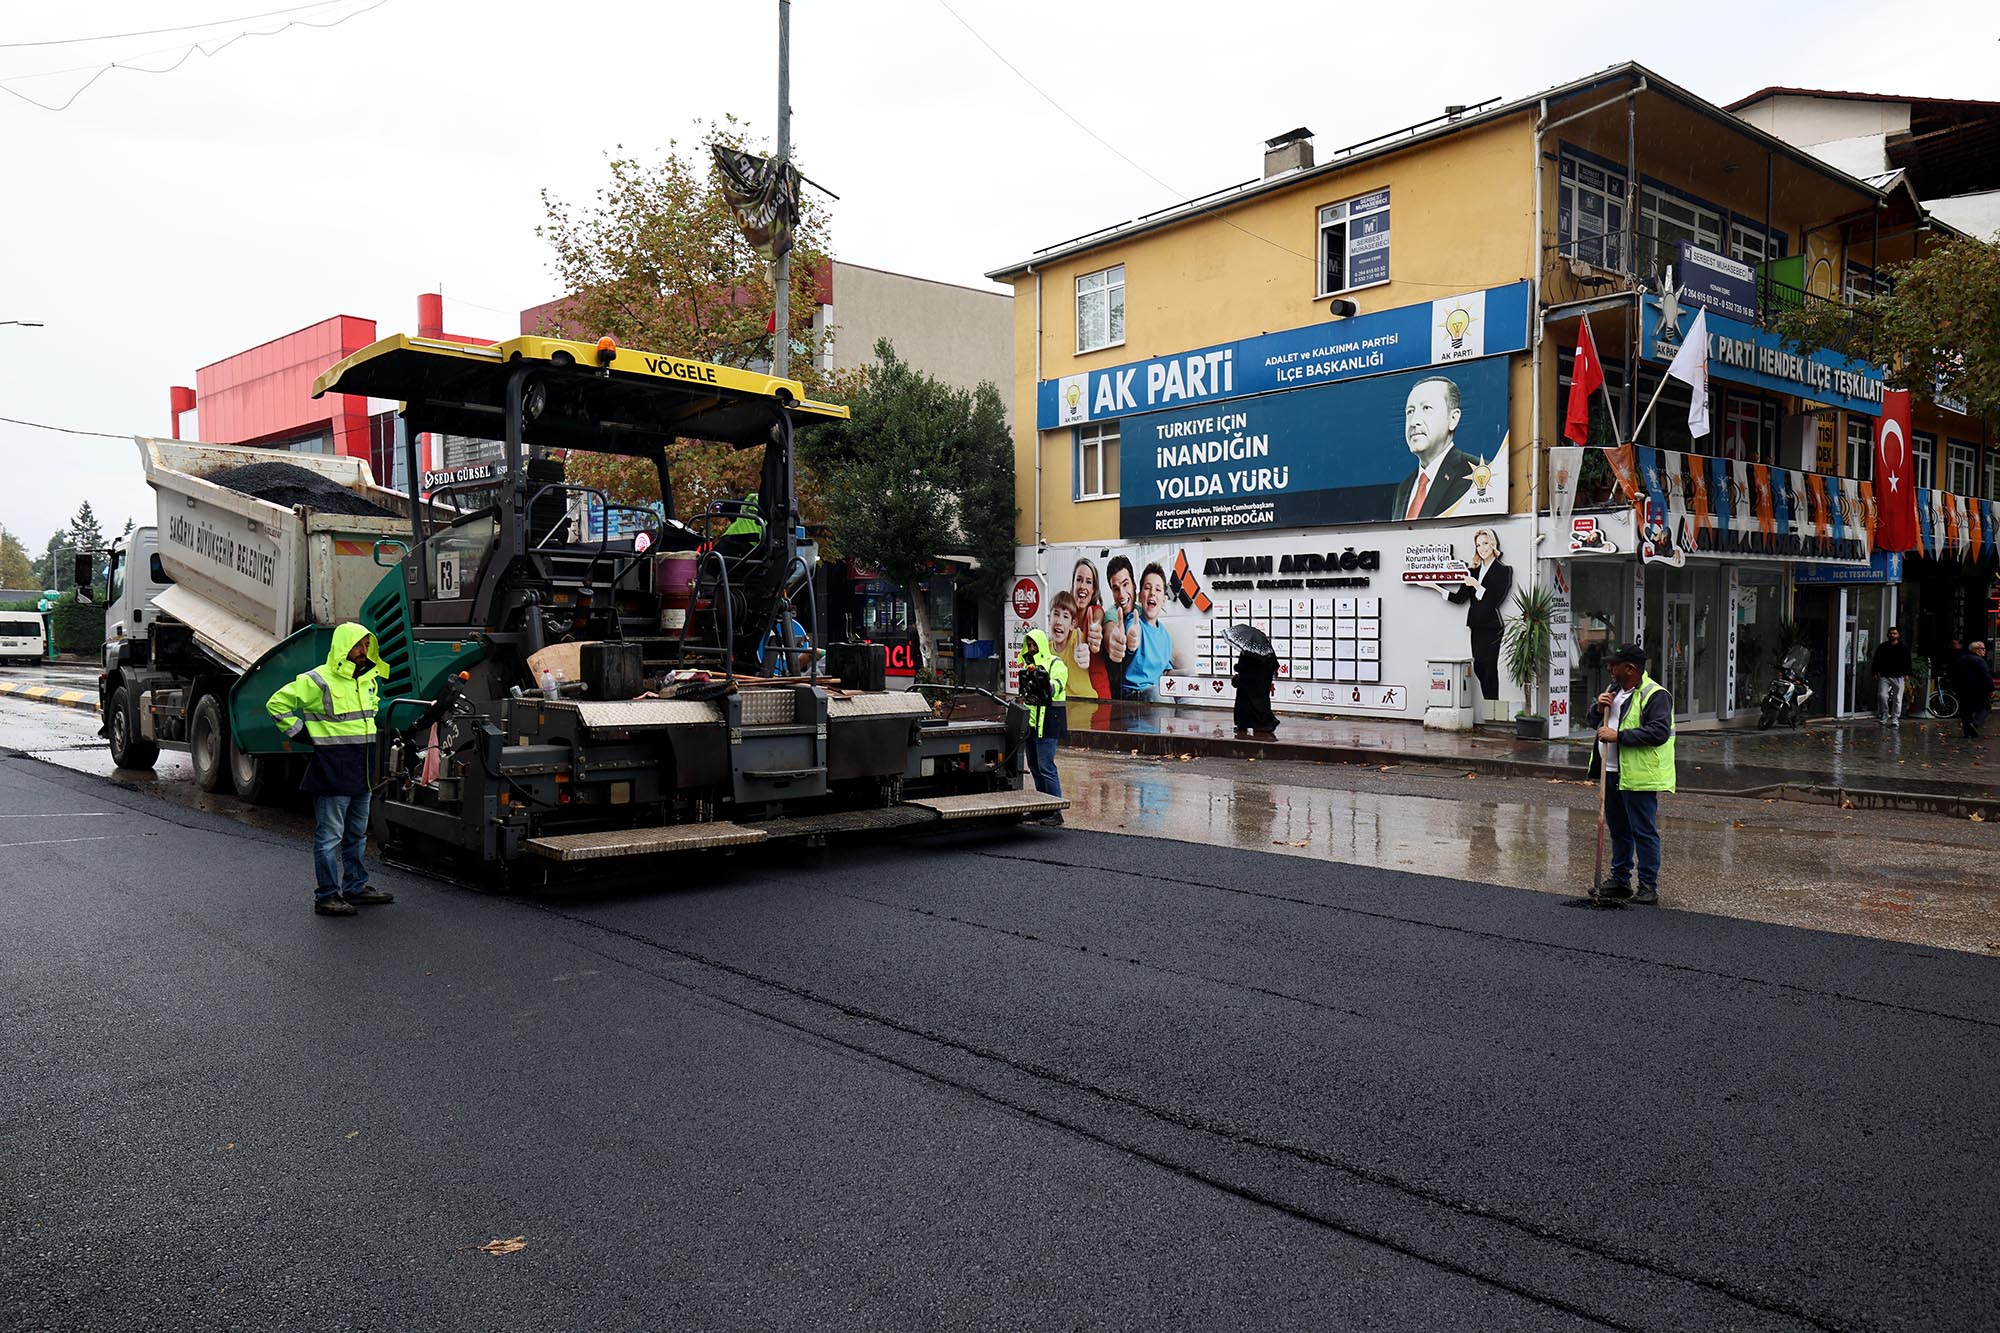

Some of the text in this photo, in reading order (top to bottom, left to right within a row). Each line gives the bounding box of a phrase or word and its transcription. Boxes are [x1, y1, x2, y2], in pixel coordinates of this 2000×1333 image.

[1693, 250, 1716, 267] SERBEST
[1265, 332, 1399, 367] ADALET ve KALKINMA PARTİSİ
[1441, 349, 1473, 361] AK PARTİ
[644, 355, 717, 384] VÖGELE
[1094, 348, 1233, 414] AK PARTİ
[1276, 350, 1384, 383] İLÇE BAŞKANLIĞI
[1718, 335, 1756, 369] PARTİ
[1760, 346, 1804, 382] HENDEK
[1807, 354, 1831, 394] İLÇE
[1834, 367, 1884, 403] TEŞKİLATI
[1156, 412, 1247, 440] TÜRKİYE İÇİN
[1156, 432, 1269, 469] İNANDIĞIN
[434, 471, 455, 485] SEDA
[457, 465, 491, 482] GÜRSEL
[1156, 466, 1289, 500] YOLDA YÜRÜ
[1155, 510, 1274, 531] RECEP TAYYİP ERDOĞAN
[1176, 508, 1190, 516] Genel
[1212, 505, 1231, 513] Türkiye
[1232, 502, 1274, 511] Cumhurbaşkanı
[196, 520, 234, 569] BÜYÜKŞEHİR
[236, 543, 277, 588] BELEDİYESİ
[1203, 546, 1381, 576] AYHAN AKDAĞCI
[1405, 552, 1450, 563] Korumak İçin
[1406, 546, 1449, 555] Değerlerinizi
[441, 561, 452, 590] F3
[1849, 569, 1883, 578] TEŞKİLATI
[1728, 599, 1736, 712] SİGORTA
